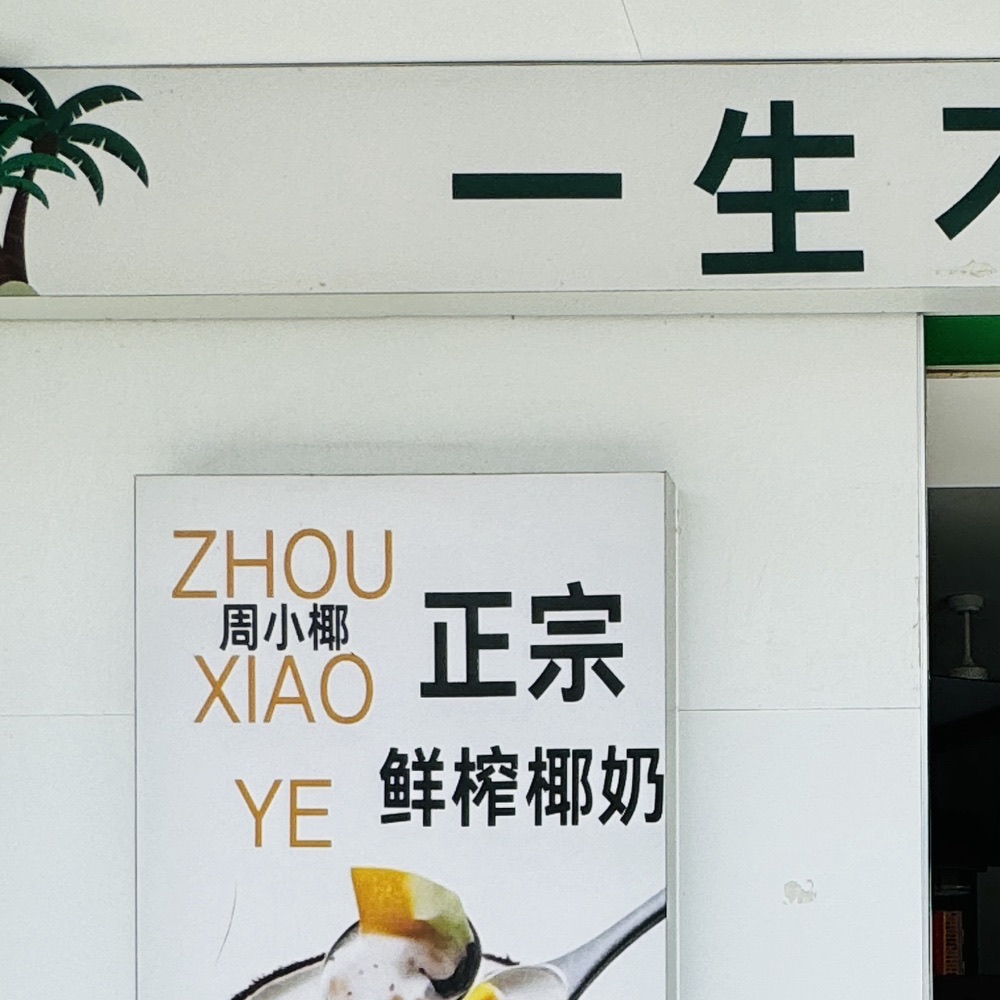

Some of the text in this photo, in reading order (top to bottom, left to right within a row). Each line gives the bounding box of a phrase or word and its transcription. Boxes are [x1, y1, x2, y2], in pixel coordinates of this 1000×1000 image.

[172, 529, 393, 600] ZHOU
[219, 603, 350, 651] 周小椰
[420, 582, 625, 702] 正宗
[195, 653, 374, 724] XIAO
[235, 779, 332, 848] YE
[379, 746, 664, 826] 鲜榨椰奶
